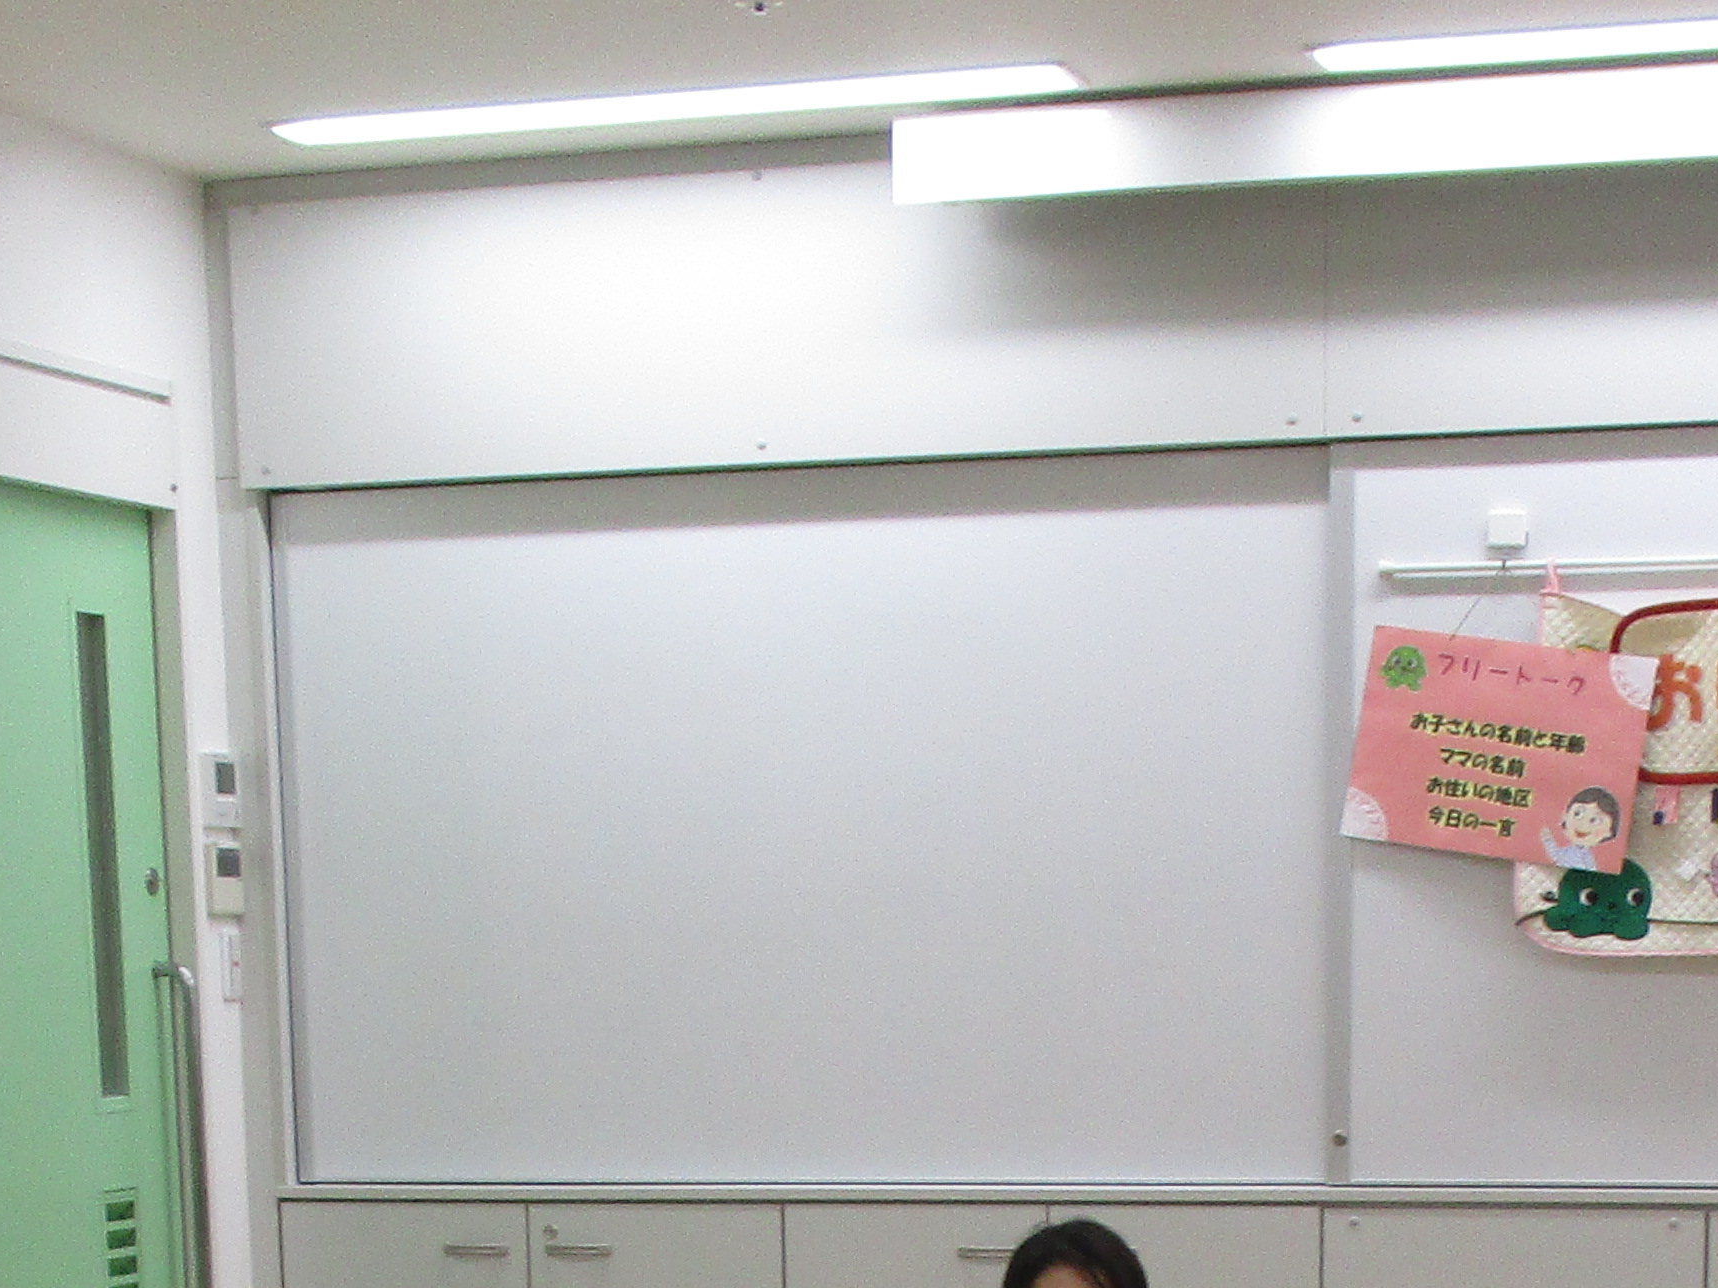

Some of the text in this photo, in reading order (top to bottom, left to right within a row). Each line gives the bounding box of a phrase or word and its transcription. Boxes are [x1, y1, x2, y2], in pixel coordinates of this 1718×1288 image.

[1438, 653, 1585, 695] フリートーク
[1439, 748, 1526, 778] ママの名前
[1428, 806, 1515, 837] 今日の一言
